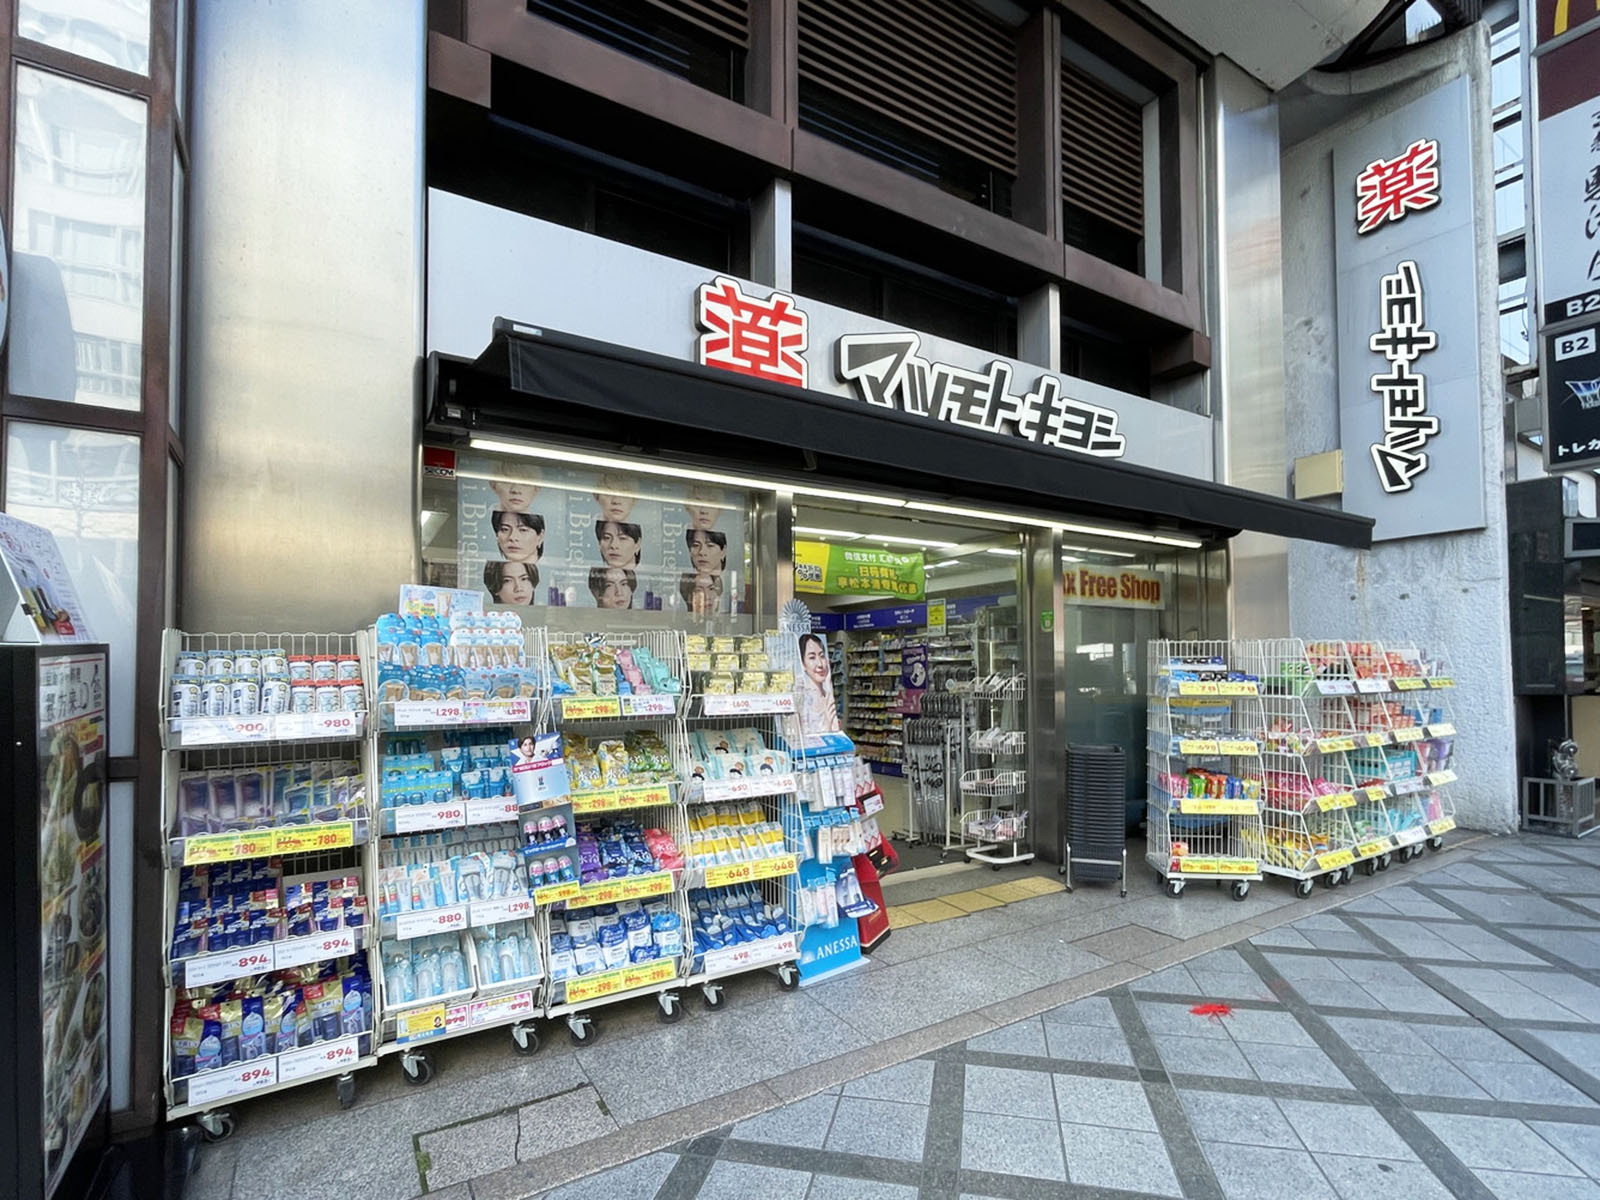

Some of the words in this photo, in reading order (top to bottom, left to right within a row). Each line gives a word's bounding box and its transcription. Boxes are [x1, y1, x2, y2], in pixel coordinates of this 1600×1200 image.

[1357, 138, 1440, 235] 薬
[1561, 336, 1590, 354] B2
[1370, 260, 1438, 493] マツモトキヨシ
[840, 333, 1126, 457] マツモトキヨシ
[1079, 568, 1117, 598] Free
[1120, 573, 1161, 602] Shop
[323, 718, 351, 728] 980
[437, 810, 461, 820] 980
[317, 834, 337, 845] 780
[727, 867, 750, 879] 648
[438, 914, 462, 924] 880
[323, 938, 350, 951] 894
[816, 935, 858, 960] ANESSA
[238, 953, 269, 968] 894
[326, 1046, 354, 1060] 894
[241, 1067, 271, 1082] 894
